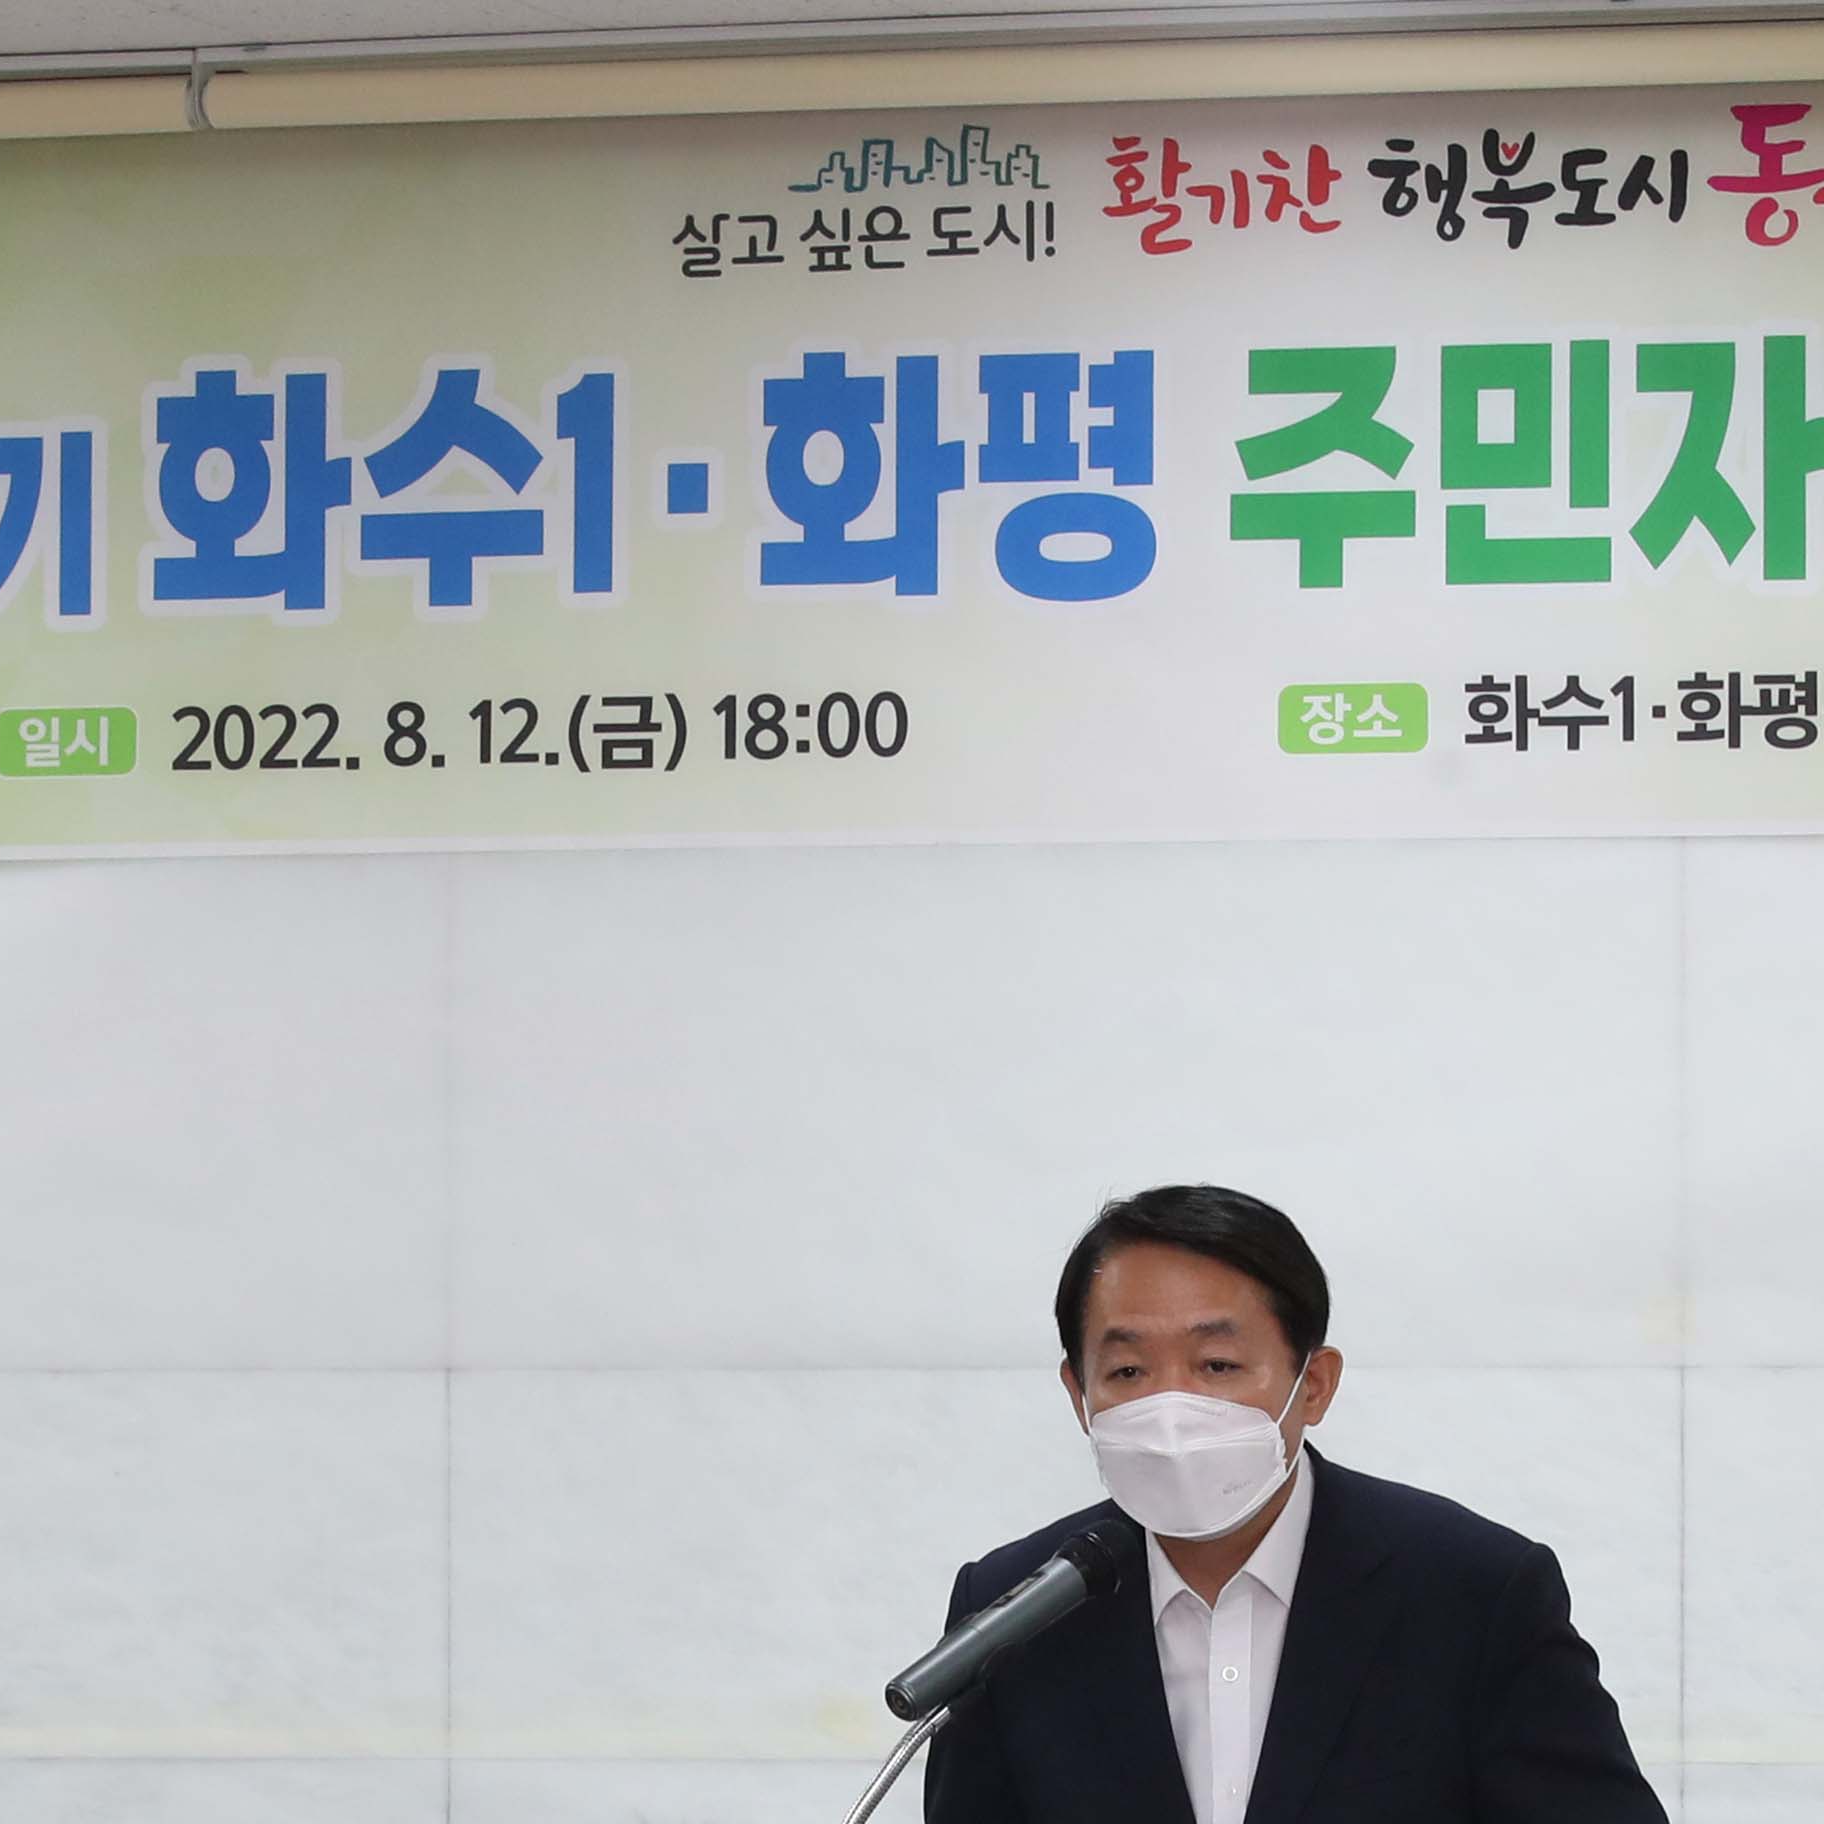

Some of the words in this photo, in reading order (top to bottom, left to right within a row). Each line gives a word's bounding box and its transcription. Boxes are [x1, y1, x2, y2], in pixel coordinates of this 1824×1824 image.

[670, 211, 786, 280] 살고
[798, 204, 912, 274] 싶은
[924, 198, 1057, 264] 도시!
[1102, 135, 1344, 256] 활기찬
[1365, 126, 1690, 251] 행복도시
[17, 715, 111, 768] 일시
[170, 702, 361, 772] 2022.
[382, 699, 447, 769] 8.
[467, 692, 688, 774] 12.(금)
[711, 690, 909, 761] 18:00
[1299, 692, 1404, 746] 장소
